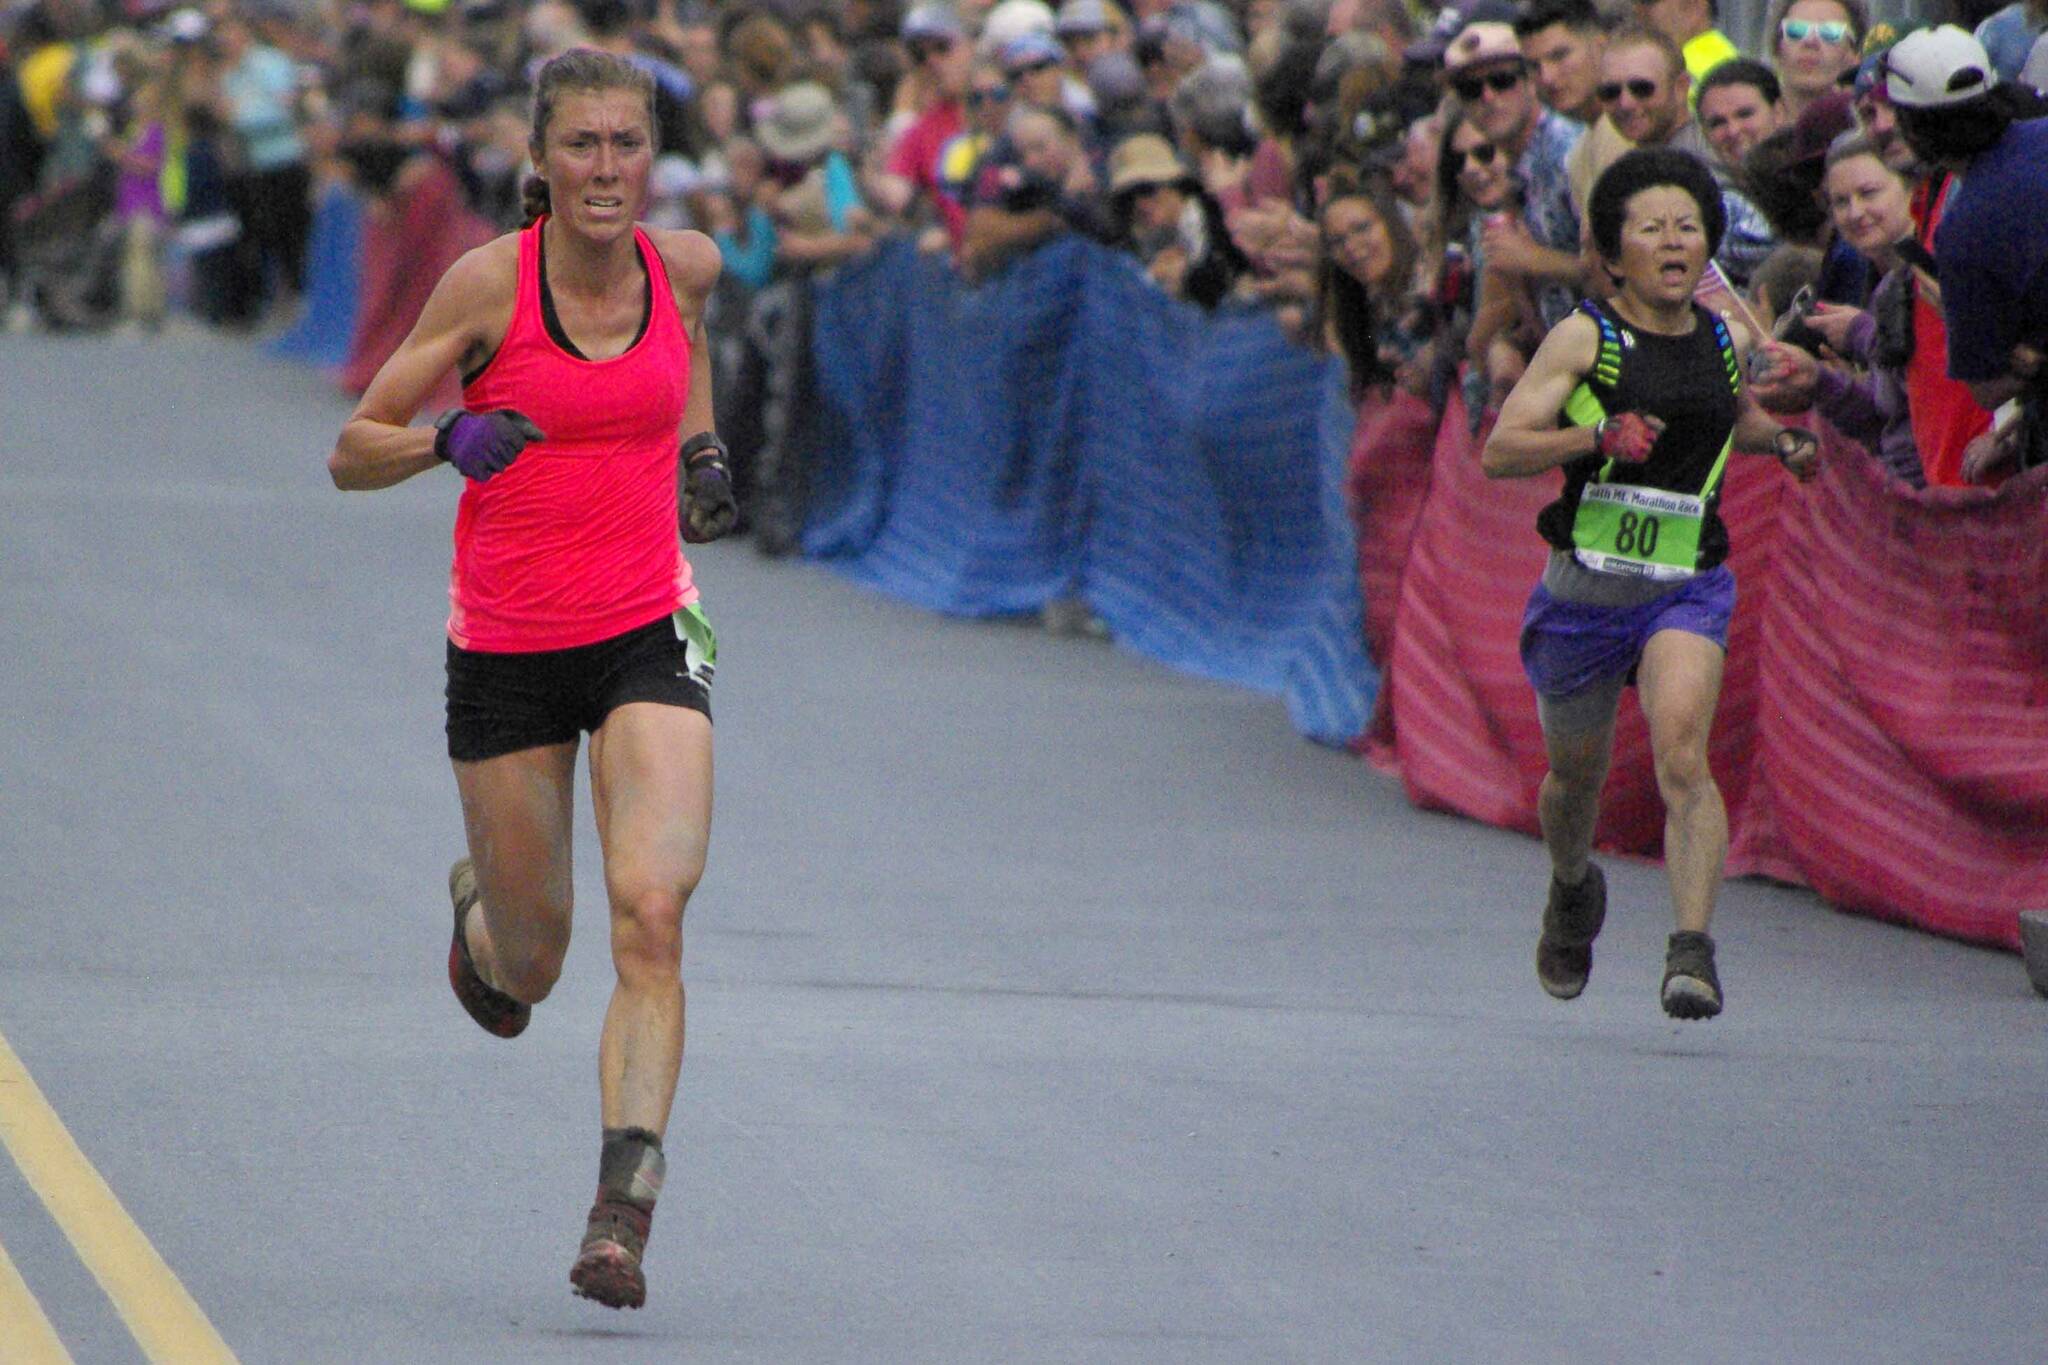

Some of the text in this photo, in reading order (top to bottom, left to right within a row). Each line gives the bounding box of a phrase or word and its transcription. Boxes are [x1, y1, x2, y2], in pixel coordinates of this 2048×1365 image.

[1631, 492, 1677, 512] Marathon
[1678, 500, 1700, 514] Race
[1615, 510, 1660, 558] 80
